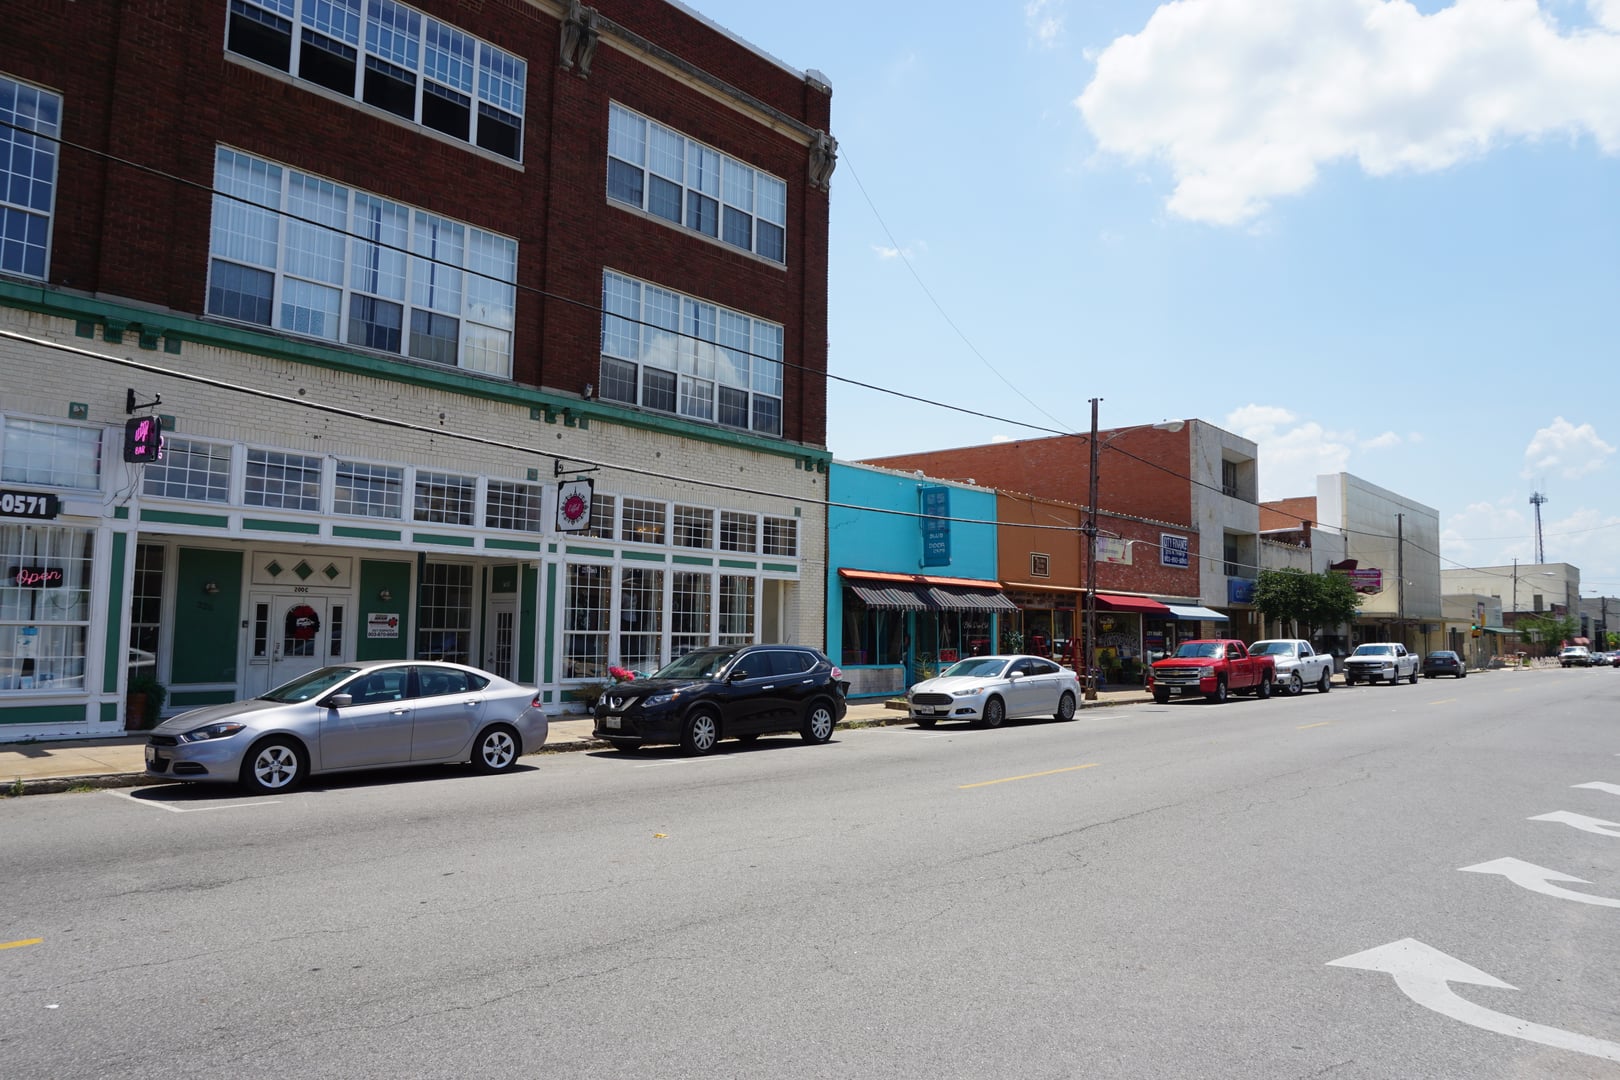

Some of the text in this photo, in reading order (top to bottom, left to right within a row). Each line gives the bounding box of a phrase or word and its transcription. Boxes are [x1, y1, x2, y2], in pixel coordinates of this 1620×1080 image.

[1163, 537, 1188, 552] CITY FINANCE
[16, 569, 61, 585] Open
